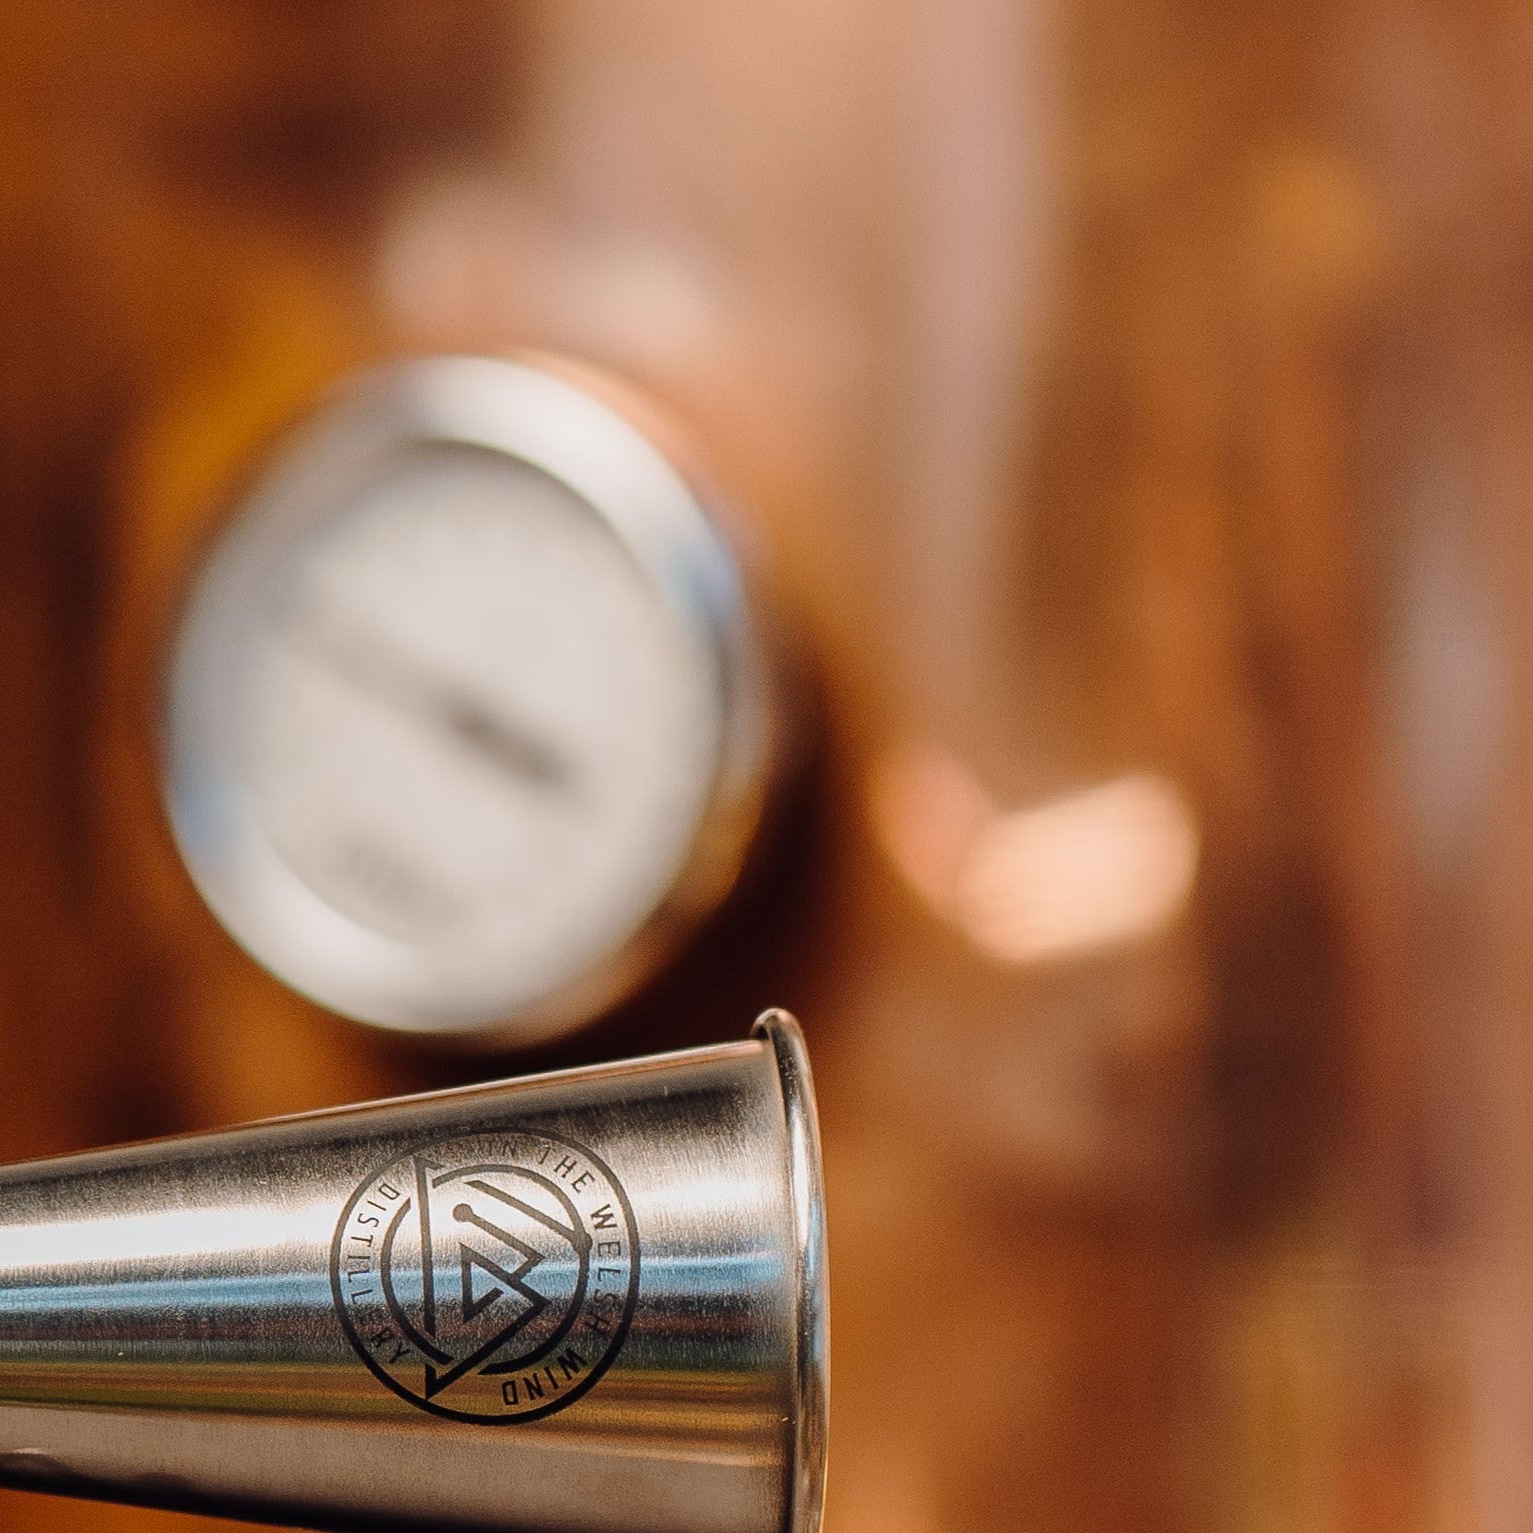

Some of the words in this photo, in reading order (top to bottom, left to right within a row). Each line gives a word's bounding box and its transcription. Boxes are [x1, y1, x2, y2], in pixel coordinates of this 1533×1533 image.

[539, 1146, 595, 1193] THE
[585, 1202, 621, 1339] WELSH
[501, 1350, 587, 1406] WIND
